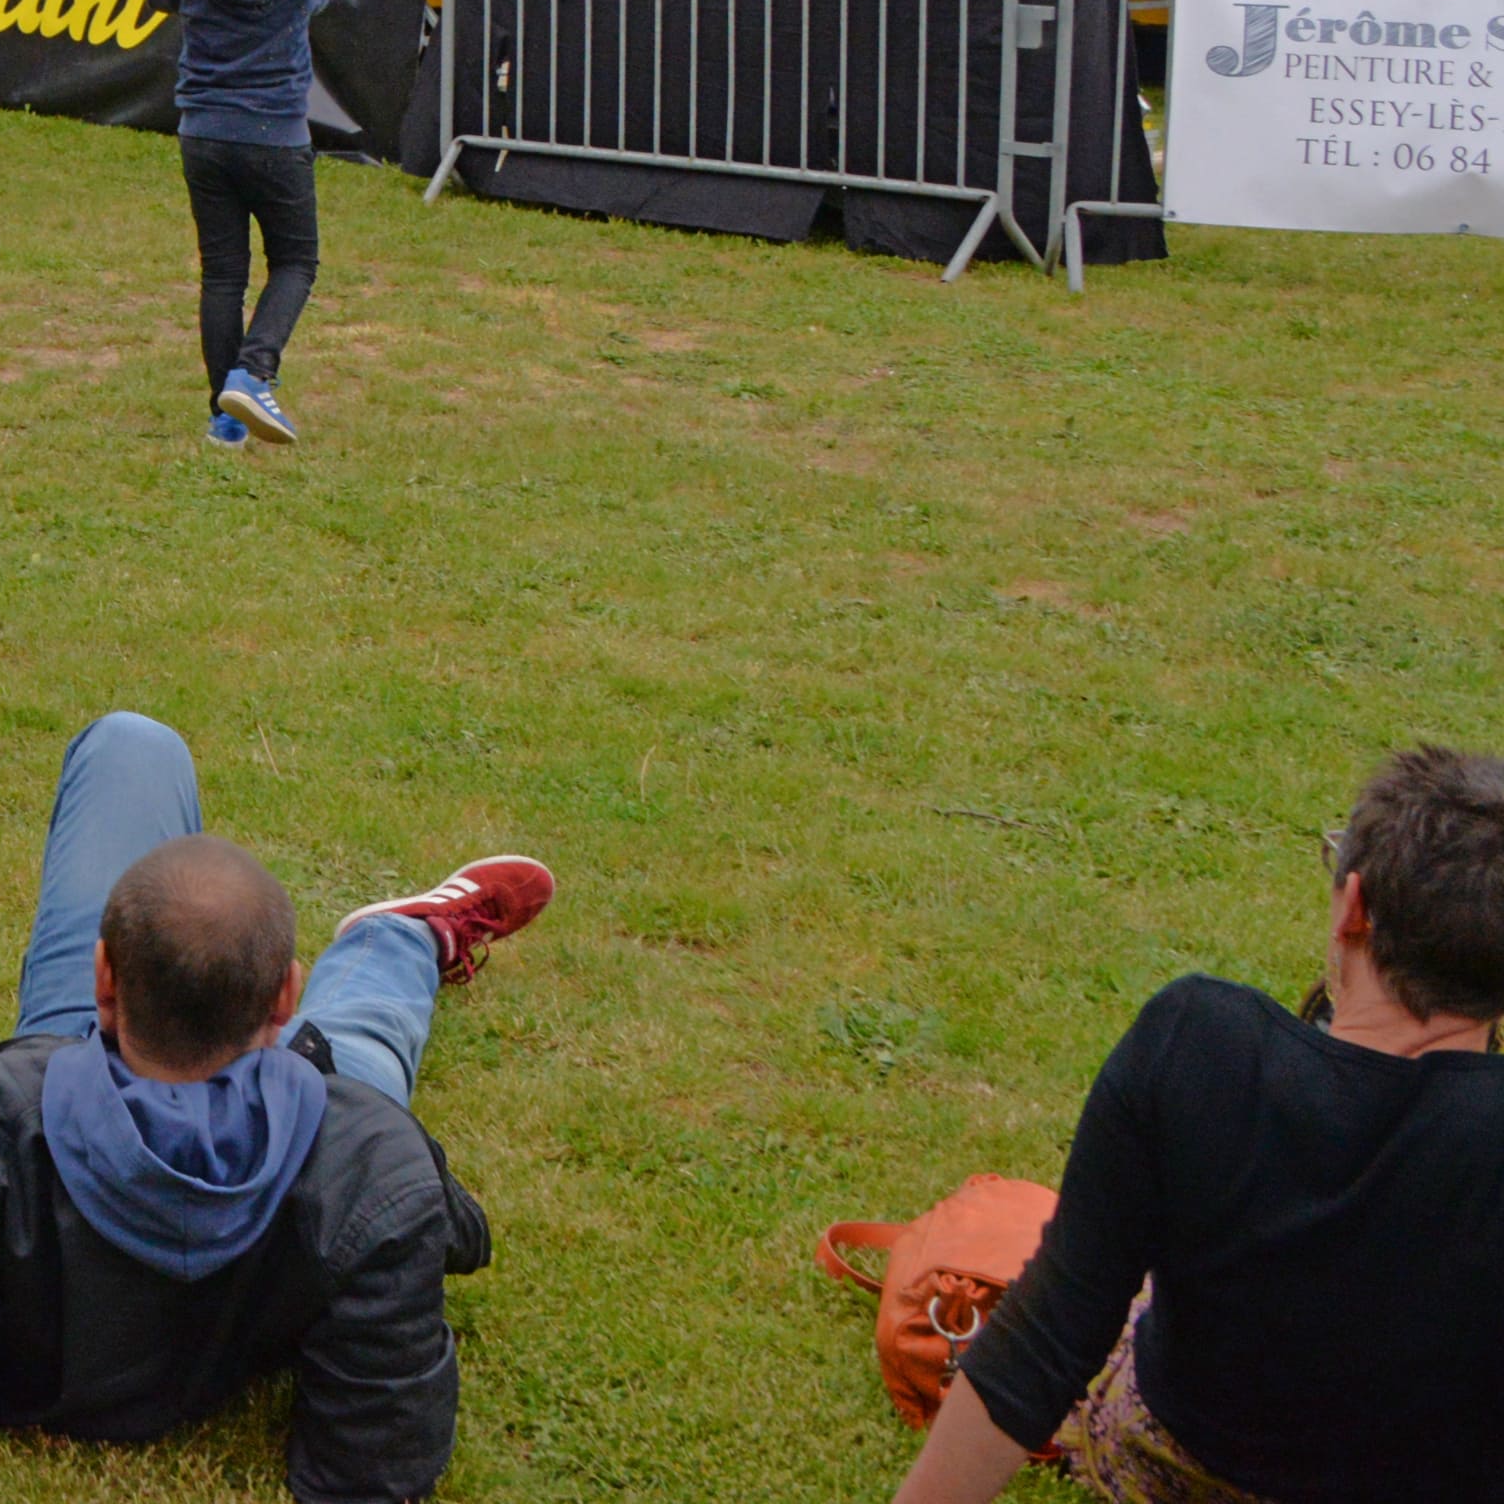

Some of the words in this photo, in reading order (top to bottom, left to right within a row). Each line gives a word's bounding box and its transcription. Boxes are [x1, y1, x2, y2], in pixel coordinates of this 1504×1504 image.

[1205, 2, 1471, 78] Jérôme
[1283, 52, 1455, 87] PEINTURE
[1467, 61, 1494, 89] &
[1393, 142, 1435, 172] 06
[1449, 145, 1492, 174] 84
